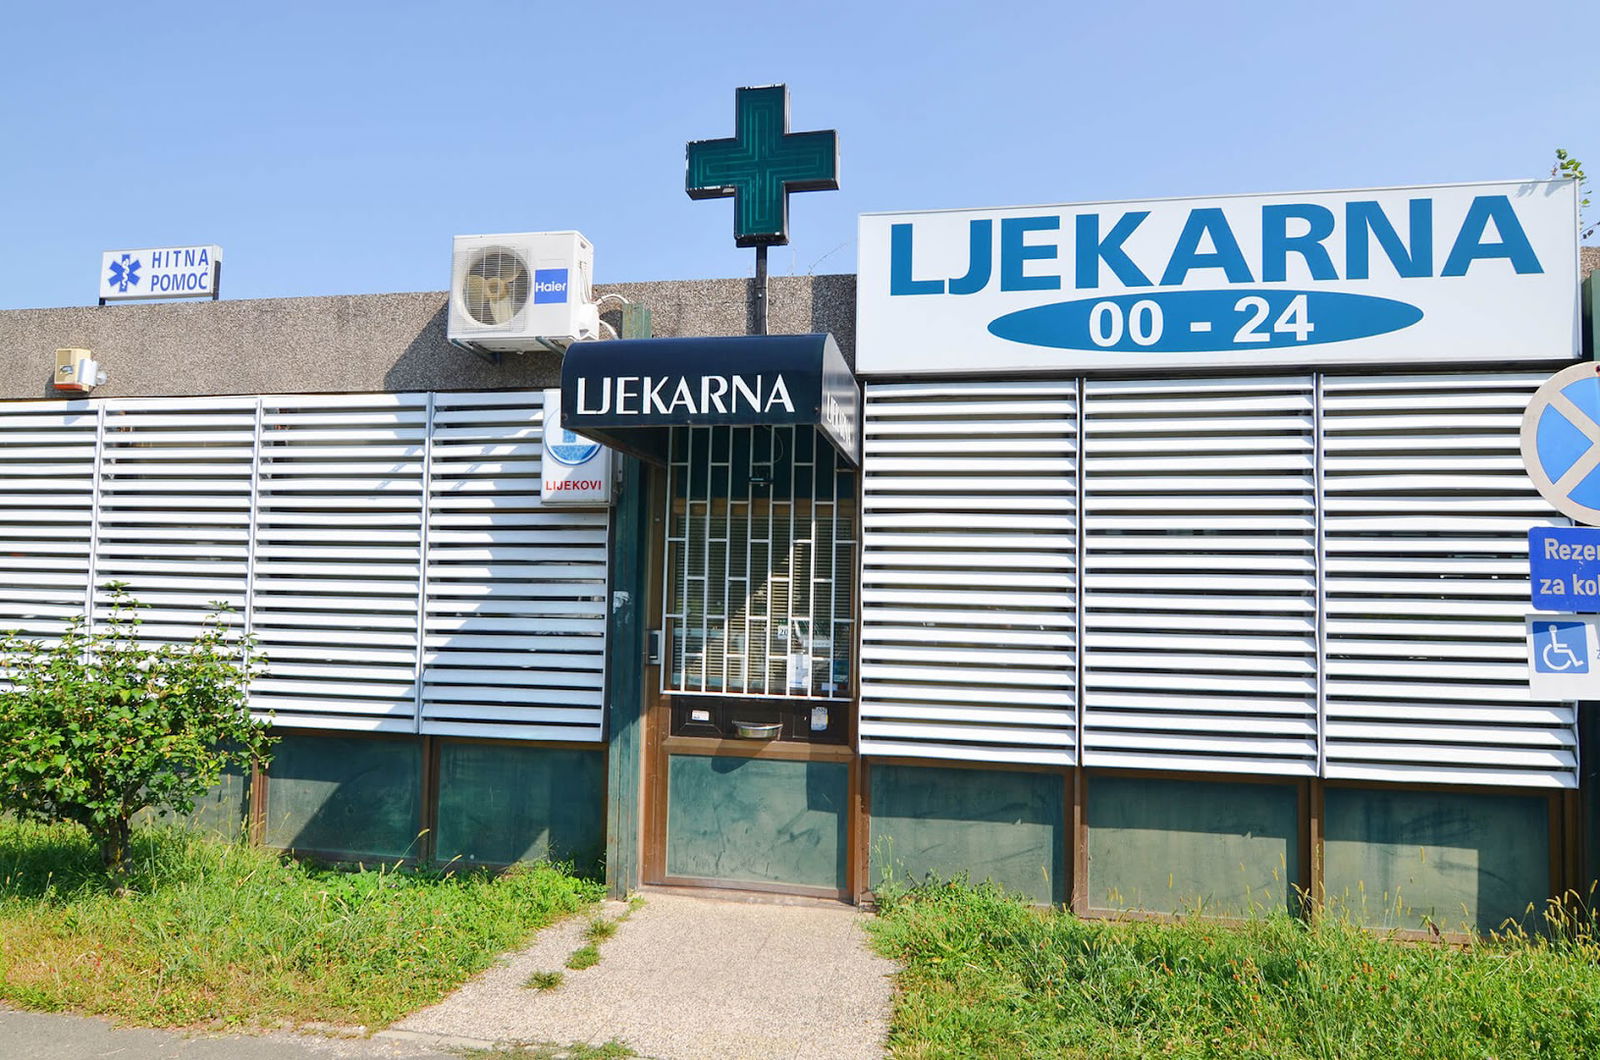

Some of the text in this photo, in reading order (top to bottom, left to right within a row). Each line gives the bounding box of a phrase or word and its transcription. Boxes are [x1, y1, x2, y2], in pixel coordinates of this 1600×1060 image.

[890, 195, 1545, 297] LJEKARNA
[151, 249, 209, 268] HITNA
[150, 267, 209, 292] POMOĆ
[535, 281, 567, 293] Haier
[1089, 294, 1315, 347] 00 - 24
[576, 374, 796, 415] LJEKARNA
[545, 480, 602, 491] LIJEKOVI
[1540, 578, 1566, 595] za
